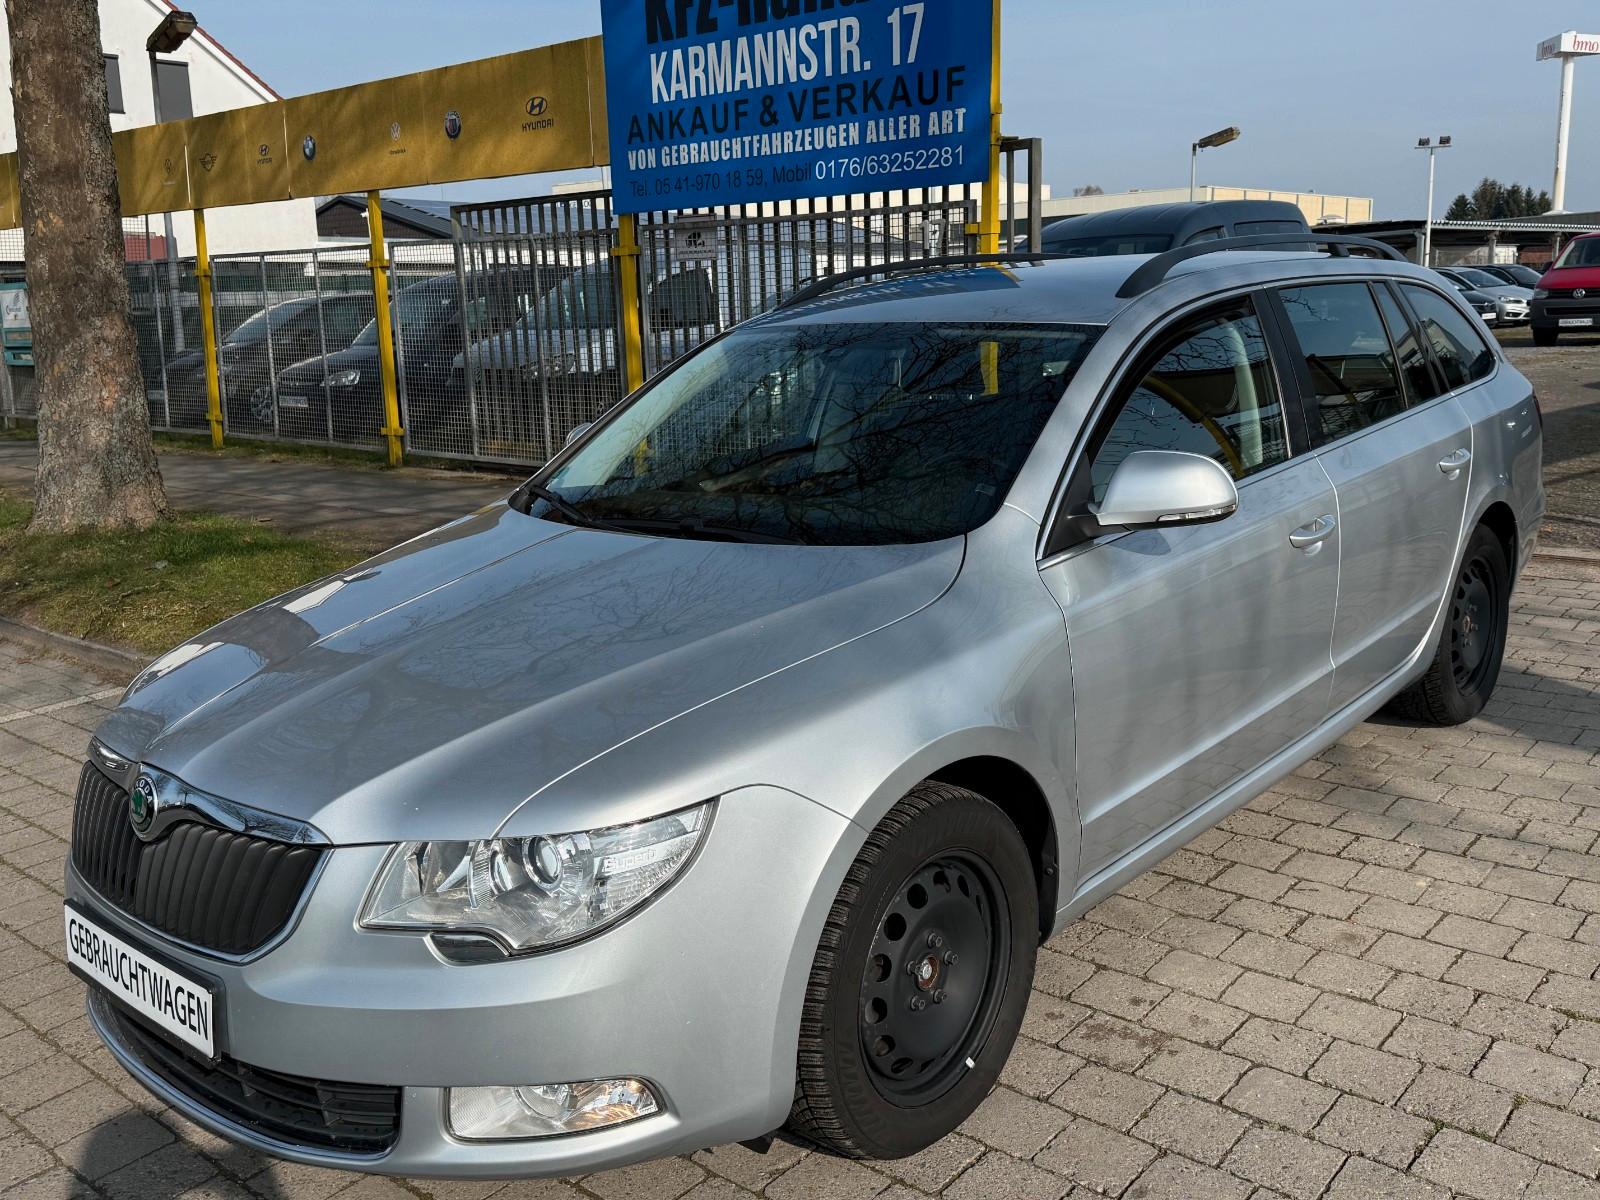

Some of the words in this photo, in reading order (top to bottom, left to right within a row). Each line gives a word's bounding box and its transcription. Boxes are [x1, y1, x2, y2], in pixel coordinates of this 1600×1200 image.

[650, 16, 871, 104] KARMANNSTR.
[887, 2, 924, 66] 17
[522, 118, 554, 132] HYUNDAI
[627, 98, 749, 144] ANKAUF
[759, 94, 779, 127] &
[787, 65, 966, 122] VERKAUF
[628, 148, 656, 171] VON
[661, 122, 860, 167] GEBRAUCHTFAHRZEUGEN
[866, 114, 921, 144] ALLER
[928, 107, 967, 136] ART
[630, 180, 650, 197] Tel.
[655, 176, 671, 195] 05
[674, 172, 720, 193] 41-970
[726, 169, 741, 188] 18
[772, 159, 812, 184] Mobil
[815, 144, 964, 180] 0176/63252281
[69, 918, 209, 1041] GEBRAUCHTWAGEN
